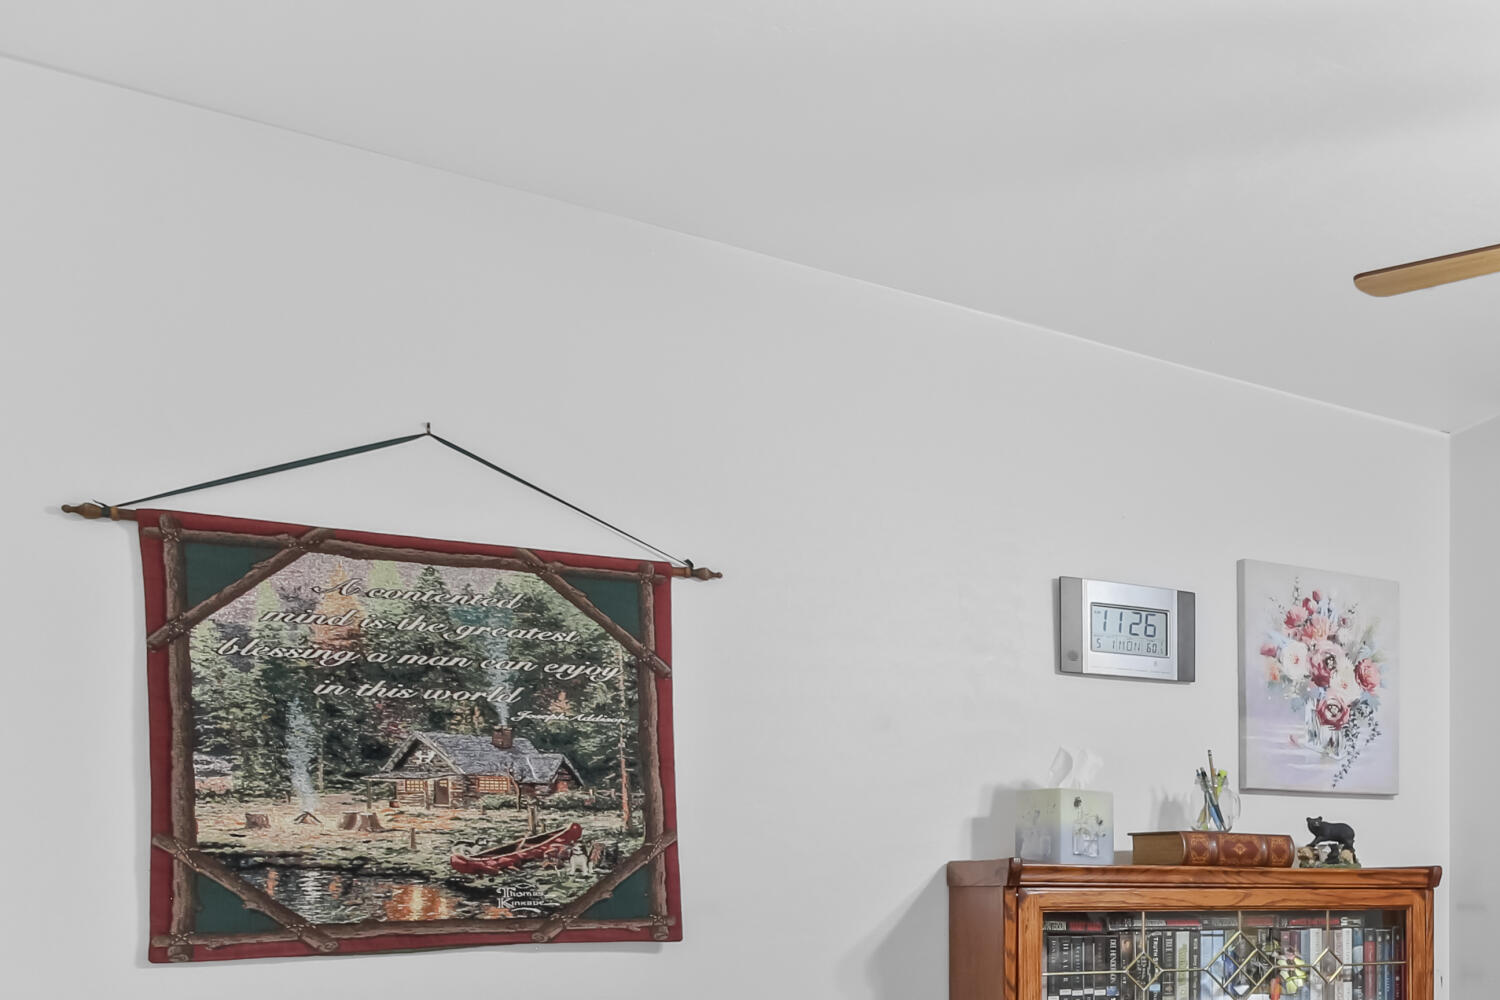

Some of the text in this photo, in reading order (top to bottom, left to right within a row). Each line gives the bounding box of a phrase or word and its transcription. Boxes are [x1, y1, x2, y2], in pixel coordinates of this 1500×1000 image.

[312, 578, 523, 609] A contented
[260, 609, 580, 643] mind is the greatest
[217, 637, 623, 682] blessing a man can enjoy
[313, 679, 524, 704] in this world
[496, 887, 544, 898] Thomas
